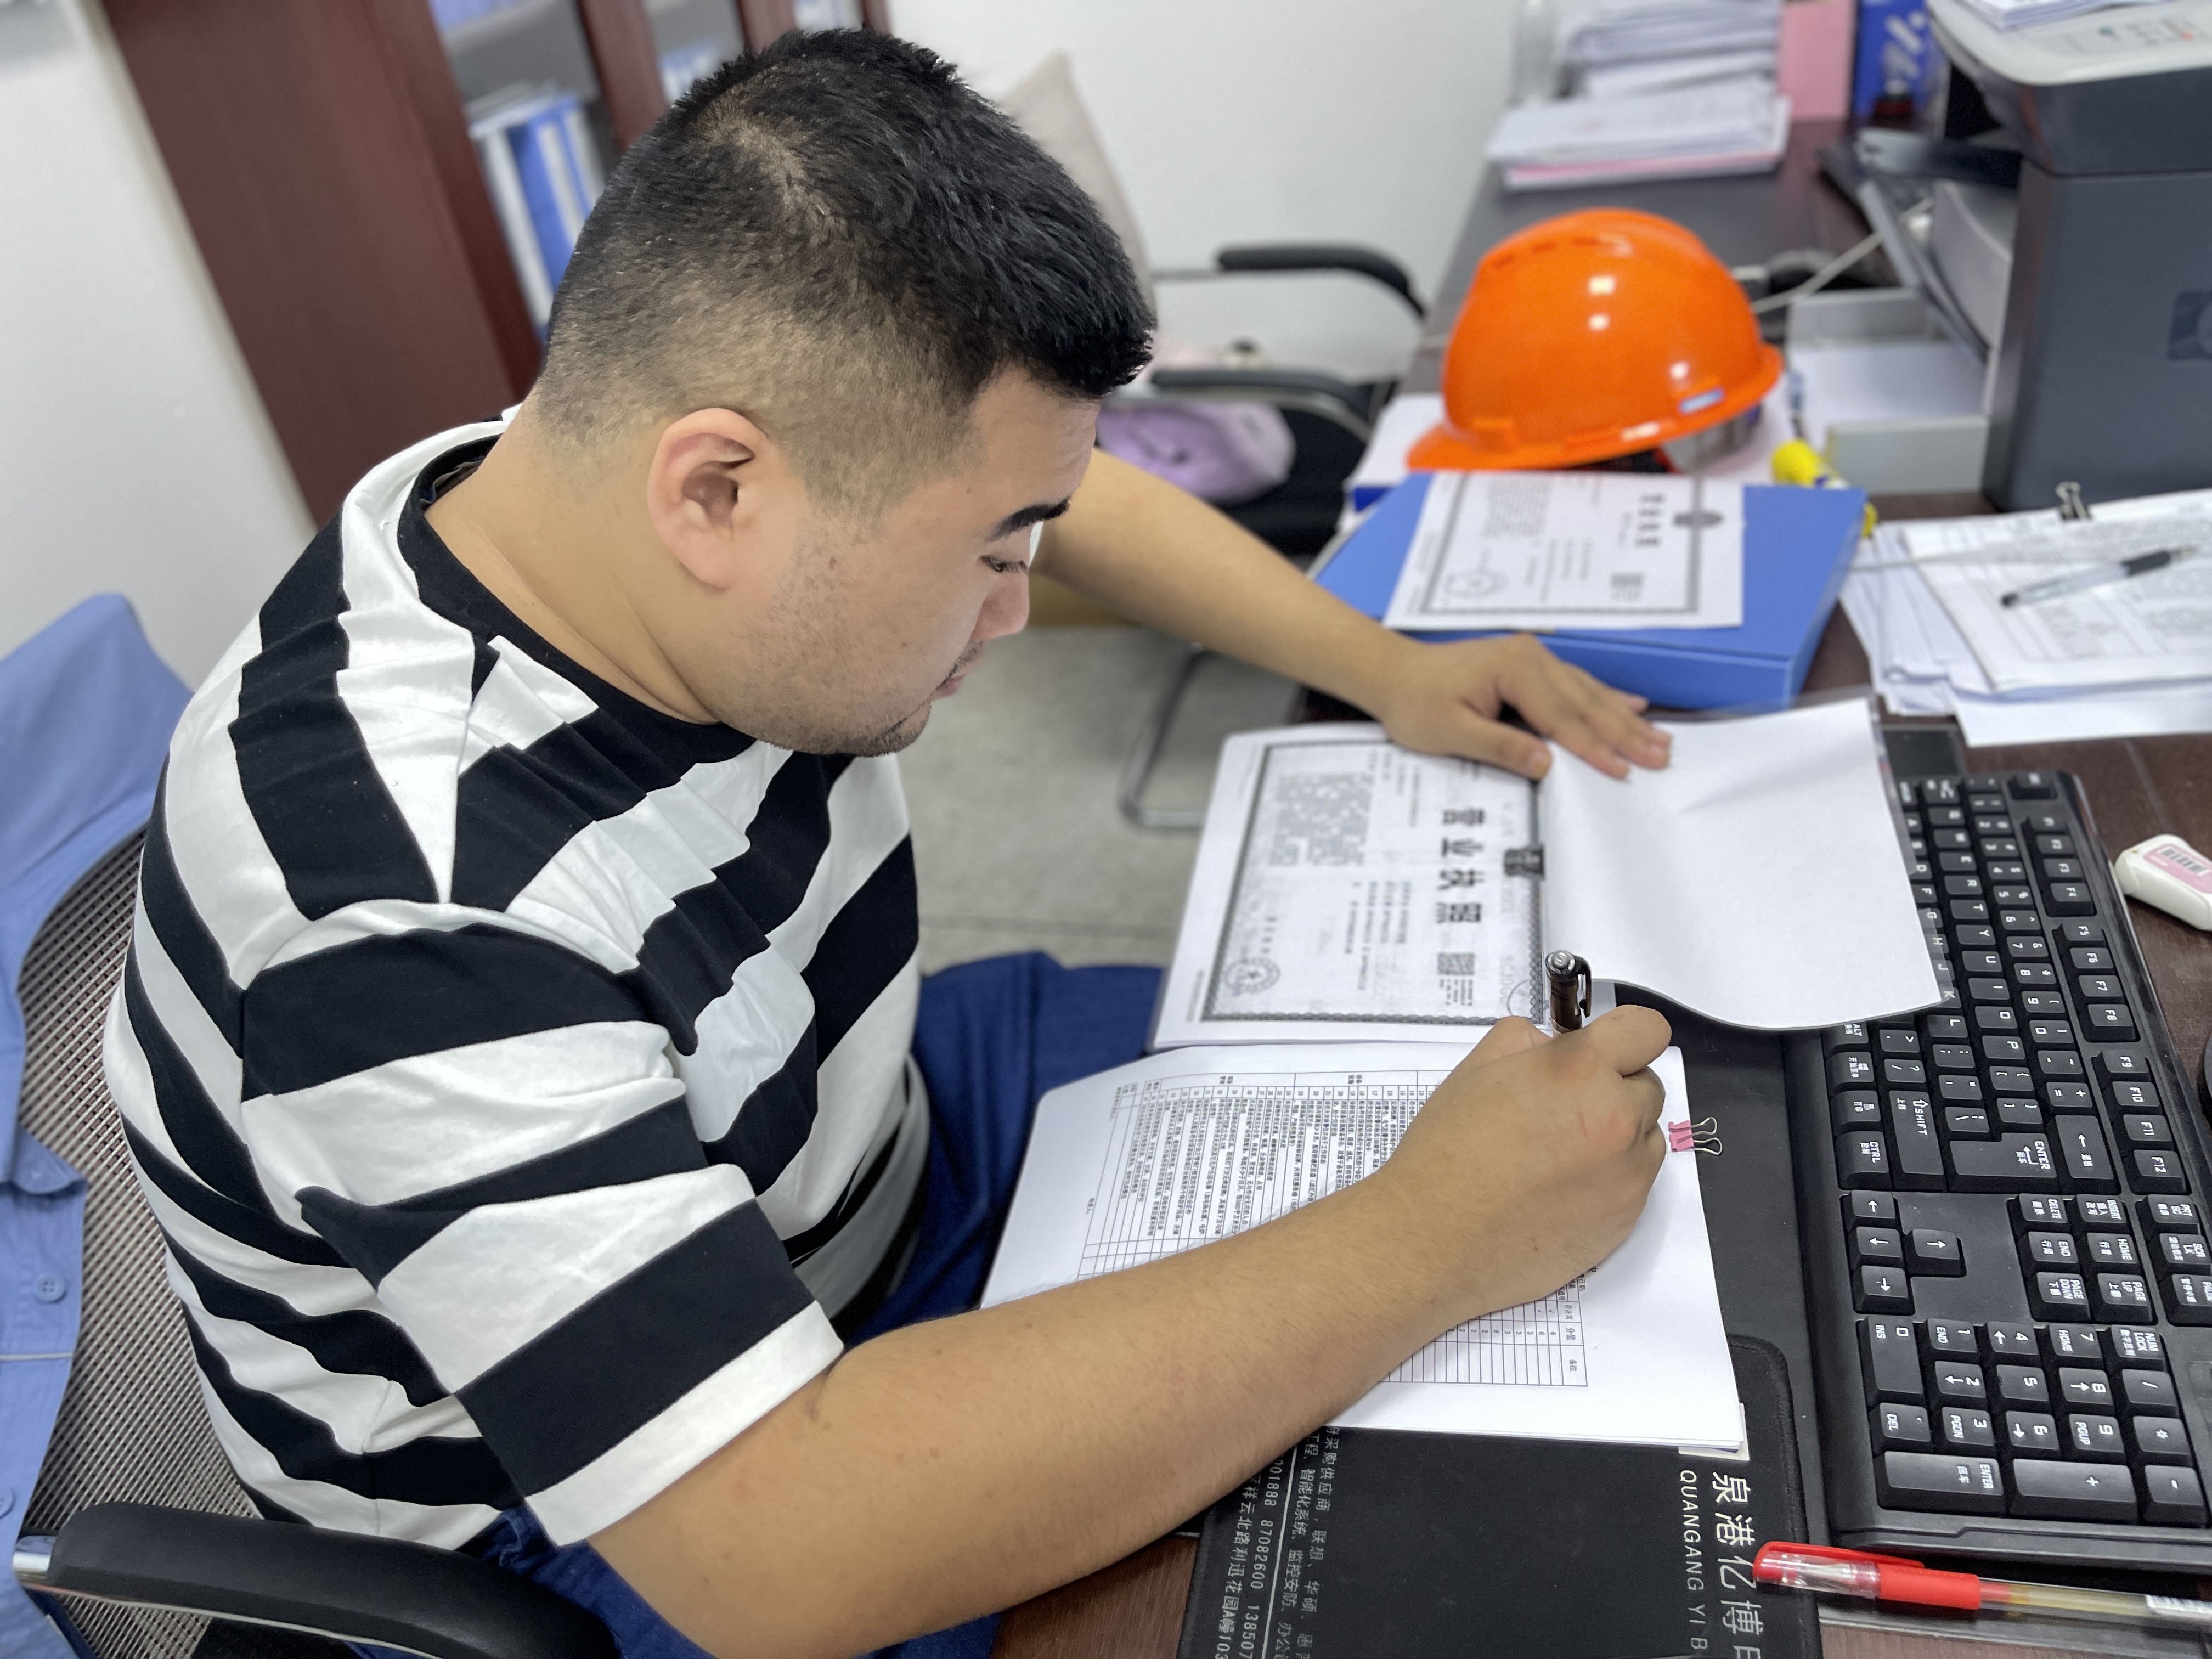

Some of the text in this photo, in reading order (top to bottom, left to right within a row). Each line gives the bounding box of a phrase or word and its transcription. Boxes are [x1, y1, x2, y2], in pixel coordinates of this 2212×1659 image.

[1435, 808, 1485, 924] 营业执照
[2059, 864, 2069, 872] F3
[2066, 888, 2077, 896] F4
[2078, 926, 2089, 935] F5
[2087, 953, 2097, 963] F6
[2096, 981, 2107, 991] F7
[2105, 1009, 2117, 1020] F8
[1853, 1024, 1862, 1036] ALT
[2007, 1041, 2018, 1049] P
[2120, 1057, 2132, 1068] F9
[2129, 1087, 2143, 1102] F10
[1915, 1108, 1927, 1135] SHIFT
[2141, 1122, 2154, 1135] F11
[1355, 1101, 1365, 1182] 配备符合国家标准或行业标准的个体防
[1869, 1141, 1880, 1163] CTRL
[2034, 1141, 2050, 1169] ENTER
[2152, 1156, 2166, 1172] F12
[2049, 1199, 2062, 1218] DELETE
[2107, 1200, 2121, 1220] INSERT
[2171, 1205, 2182, 1215] SC
[2180, 1204, 2193, 1217] PRT
[2058, 1241, 2071, 1256] END
[2117, 1239, 2132, 1260] HOME
[2183, 1244, 2194, 1254] LK
[2192, 1243, 2205, 1257] SCR
[2060, 1279, 2073, 1299] DOWN
[2070, 1279, 2084, 1299] PAGE
[2121, 1281, 2134, 1292] UP
[2132, 1282, 2146, 1301] PAGE
[1565, 1305, 1573, 1320] 否决项
[1566, 1327, 1575, 1340] 分值
[1876, 1325, 1887, 1339] INS
[1897, 1327, 1909, 1336] 0
[1937, 1327, 1948, 1343] END
[2016, 1333, 2028, 1341] 4
[2080, 1333, 2094, 1341] 7
[2058, 1329, 2073, 1352] HOME
[2134, 1332, 2146, 1351] LOCK
[2145, 1333, 2159, 1351] NUM
[1569, 1359, 1577, 1372] 备注
[1966, 1377, 1980, 1386] 2
[2024, 1377, 2038, 1386] 5
[2092, 1383, 2106, 1393] 8
[1887, 1414, 1899, 1431] DEL
[1951, 1415, 1964, 1438] PGDN
[1973, 1419, 1988, 1428] 3
[2034, 1425, 2047, 1435] 6
[2076, 1421, 2091, 1445] PGUP
[2098, 1425, 2114, 1435] 9
[1980, 1464, 1994, 1489] ENTER
[1680, 1470, 1704, 1590] QUANGANG
[1251, 1520, 1273, 1589] 87082600
[1689, 1604, 1706, 1624] YI
